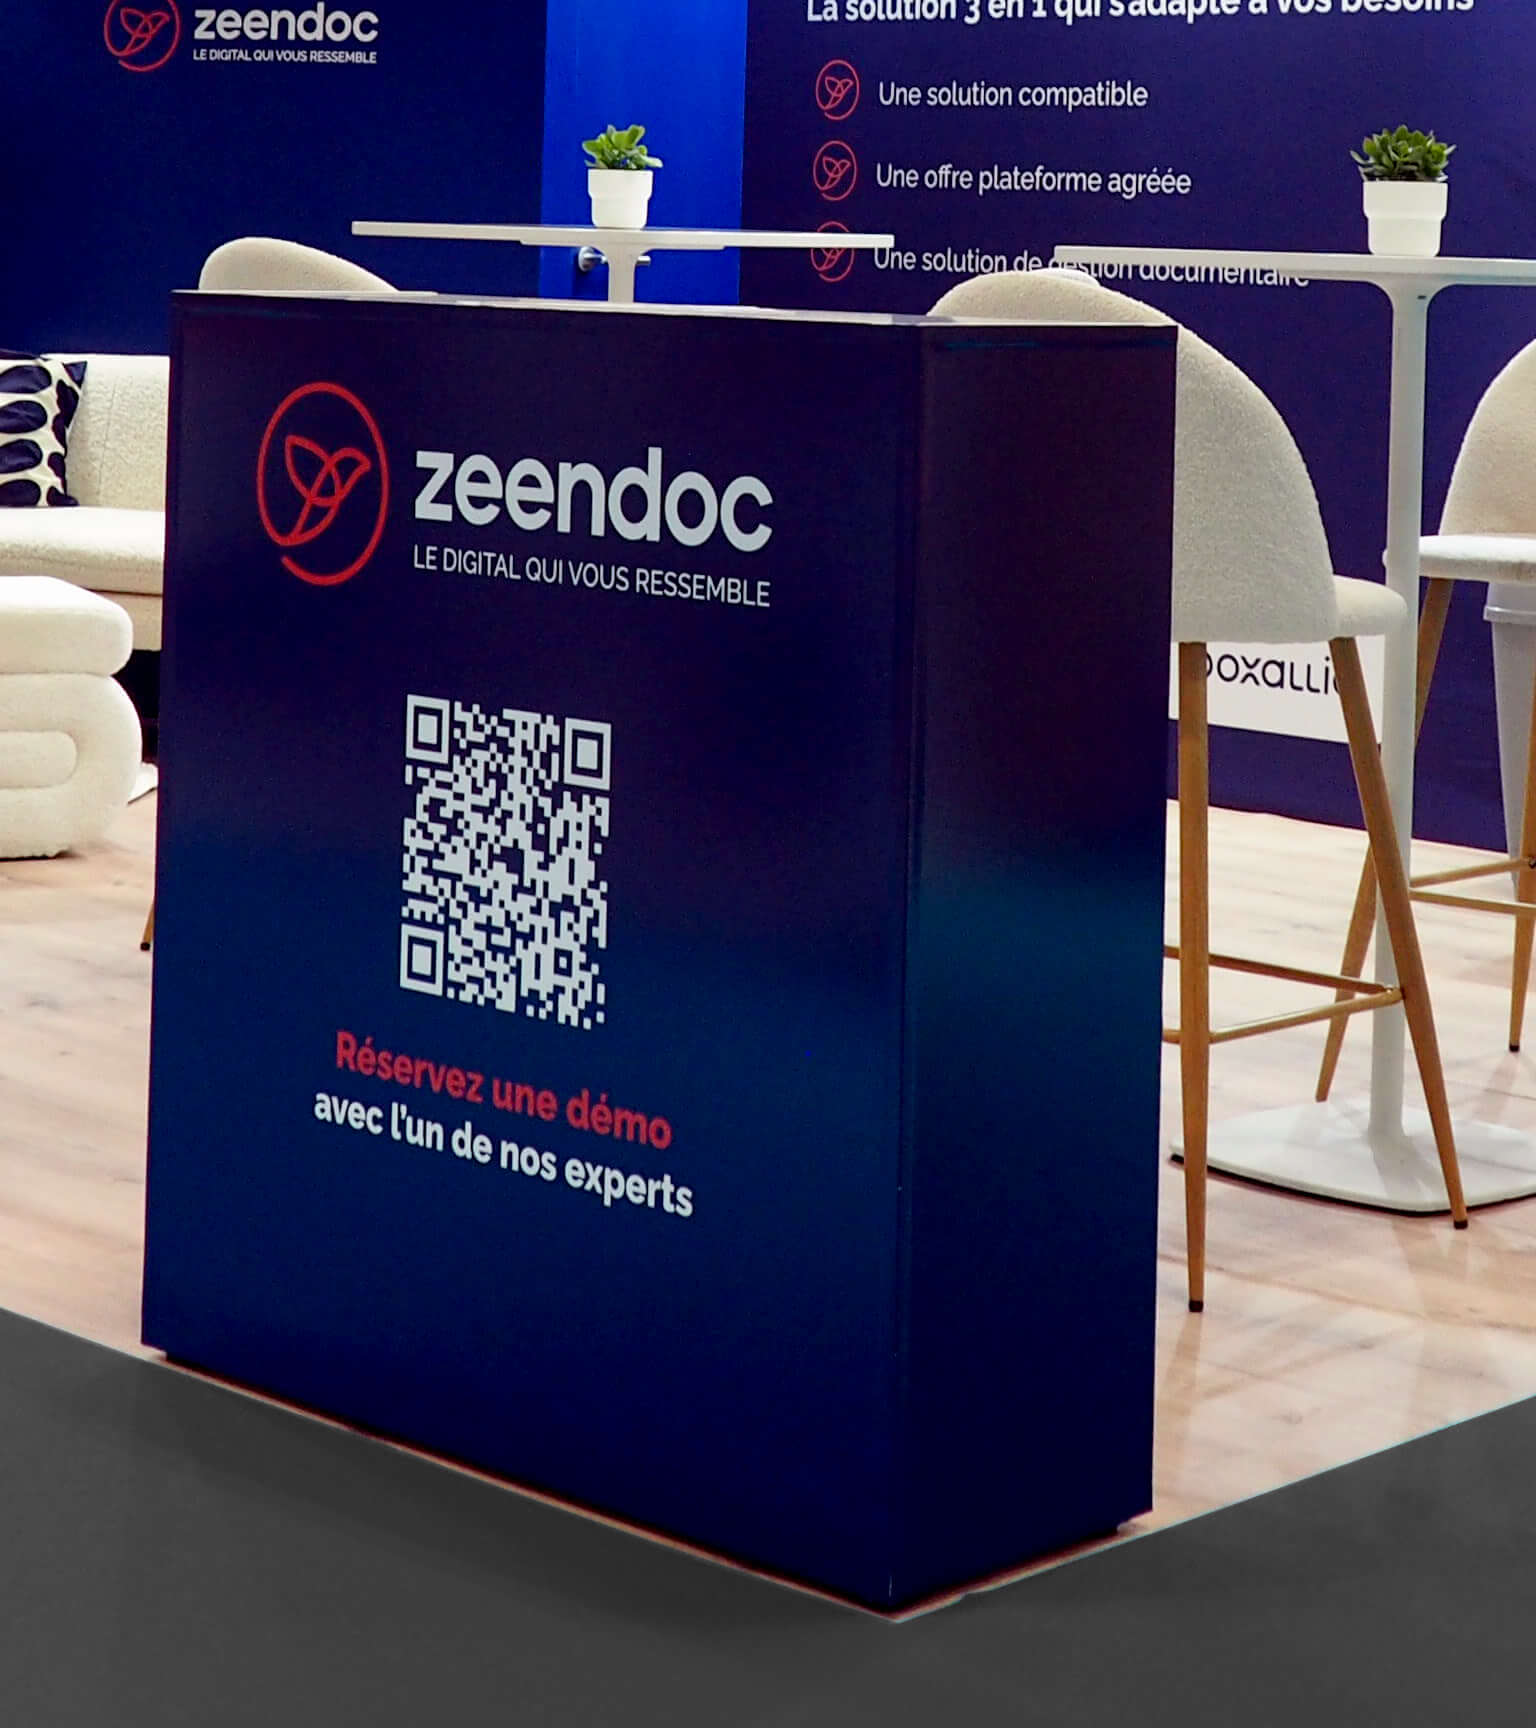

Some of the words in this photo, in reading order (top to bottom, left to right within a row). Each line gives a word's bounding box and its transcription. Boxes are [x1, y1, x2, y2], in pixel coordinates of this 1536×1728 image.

[194, 1, 378, 43] zeendoc
[194, 49, 207, 60] LE
[210, 50, 252, 61] DIGITAL
[253, 50, 273, 61] QUI
[276, 50, 307, 62] VOUS
[310, 51, 377, 64] RESSEMBLE
[879, 82, 921, 106] Une
[927, 80, 1012, 106] solution
[1018, 80, 1148, 112] compatible
[876, 163, 919, 187] Une
[924, 165, 973, 189] offre
[979, 166, 1101, 196] plateforme
[1107, 167, 1191, 199] agréée
[874, 246, 916, 270] Une
[922, 248, 1006, 274] solution
[1013, 249, 1041, 272] de
[415, 447, 773, 552] zeendoc
[414, 545, 437, 571] LE
[443, 549, 521, 581] DIGITAL
[526, 560, 563, 585] QUI
[568, 563, 630, 592] VOUS
[636, 572, 771, 608] RESSEMBLE
[336, 1031, 483, 1104] Réservez
[493, 1077, 558, 1121] une
[566, 1088, 672, 1149] démo
[314, 1091, 383, 1135] avec
[391, 1101, 444, 1152] l'un
[451, 1121, 492, 1164] de
[500, 1139, 556, 1181] nos
[564, 1158, 693, 1218] experts
